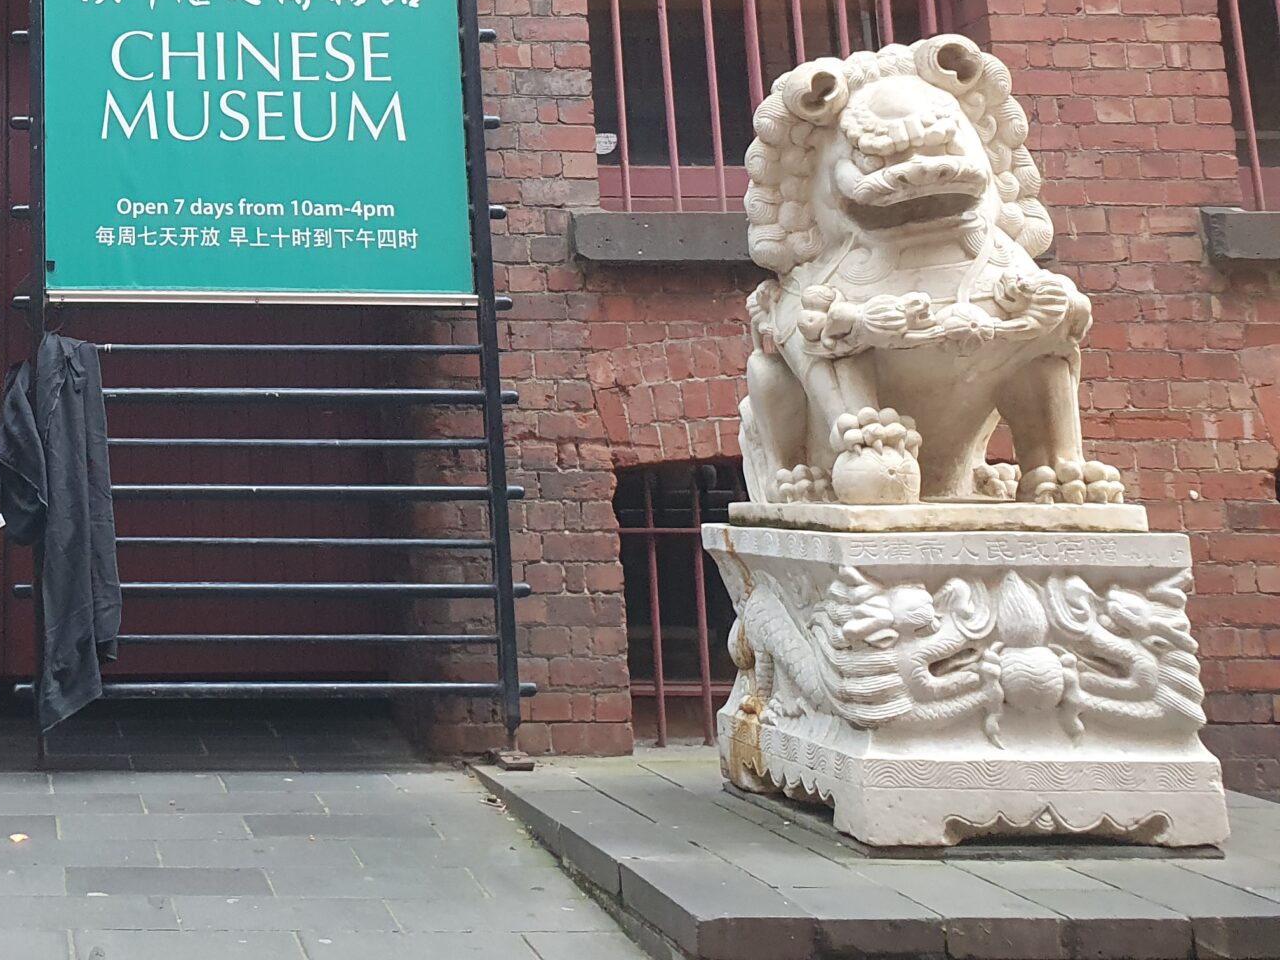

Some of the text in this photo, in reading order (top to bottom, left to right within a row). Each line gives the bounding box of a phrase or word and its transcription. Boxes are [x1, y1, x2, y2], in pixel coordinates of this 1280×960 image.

[111, 30, 393, 83] CHINESE
[101, 89, 407, 142] MUSEUM
[116, 197, 395, 221] Open 7 days from 10am-4pm
[95, 225, 419, 250] 每周七天开放 早上十时到下午四时
